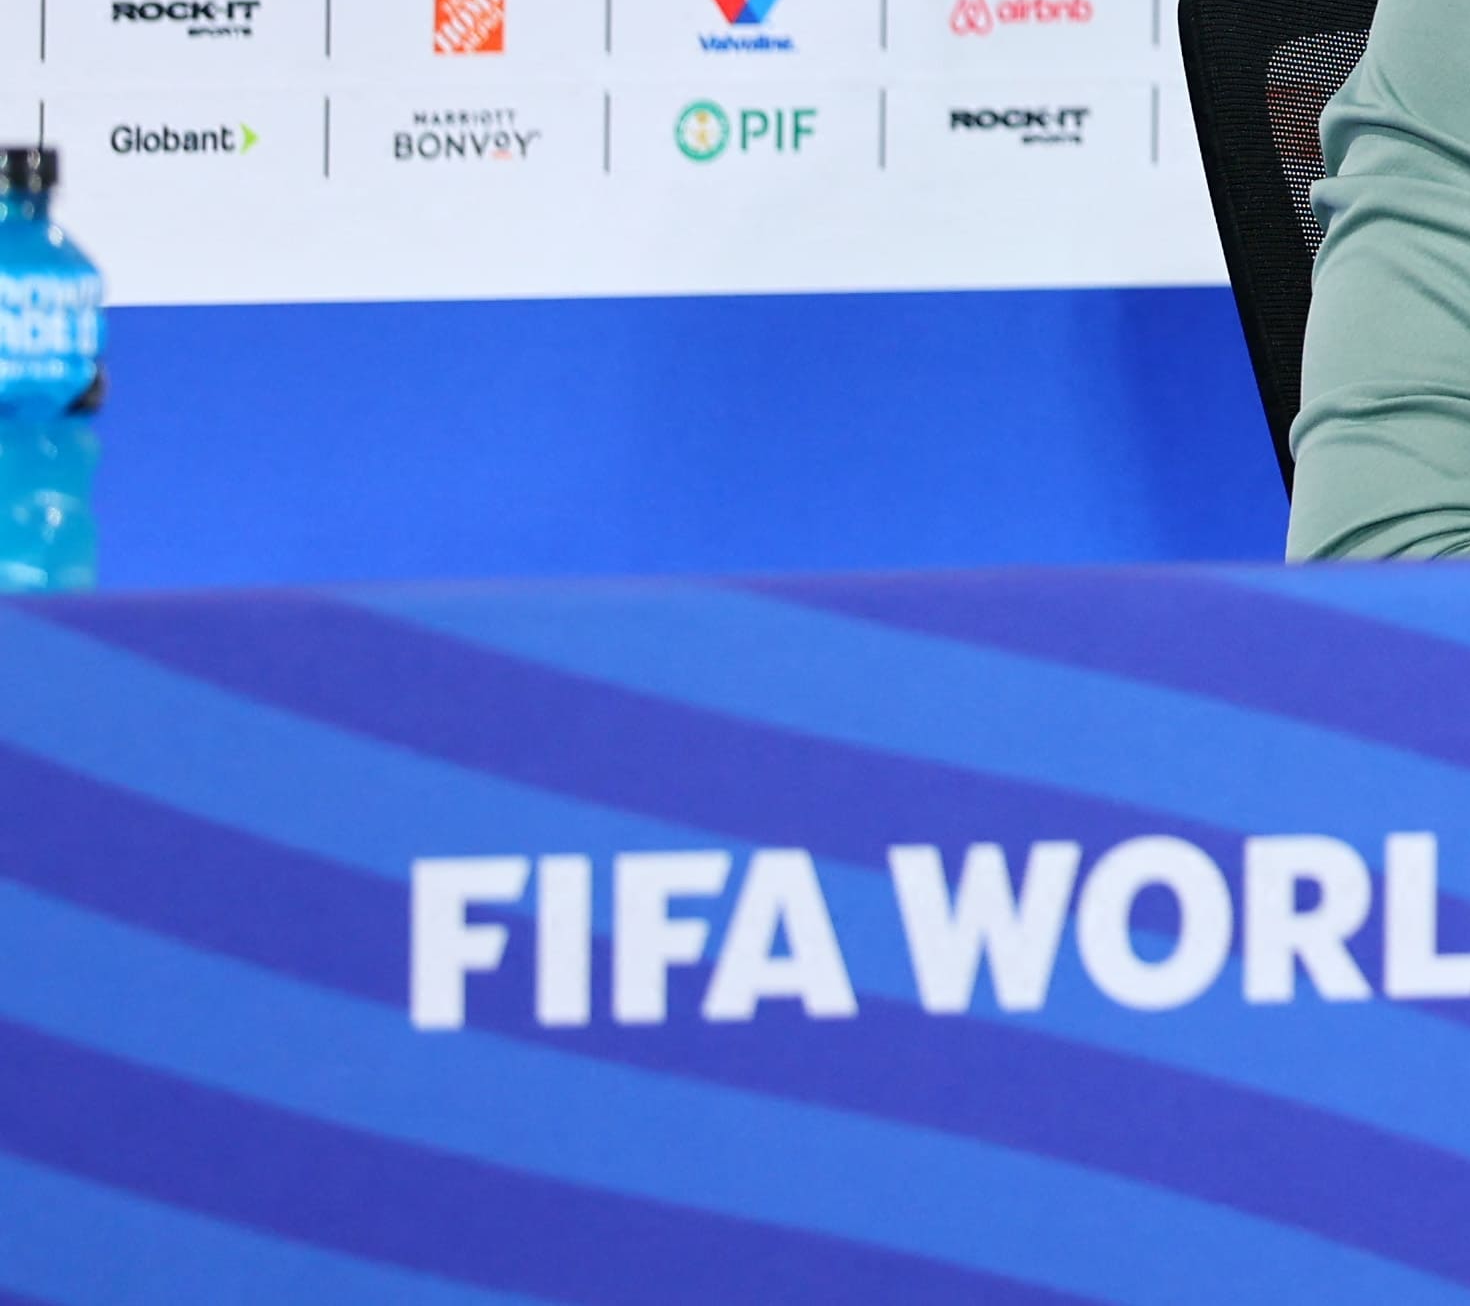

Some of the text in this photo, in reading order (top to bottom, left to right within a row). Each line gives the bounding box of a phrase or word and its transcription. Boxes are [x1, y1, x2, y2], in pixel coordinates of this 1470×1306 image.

[110, 126, 235, 156] Globant
[740, 108, 818, 154] PIF
[409, 847, 858, 1032] FIFA
